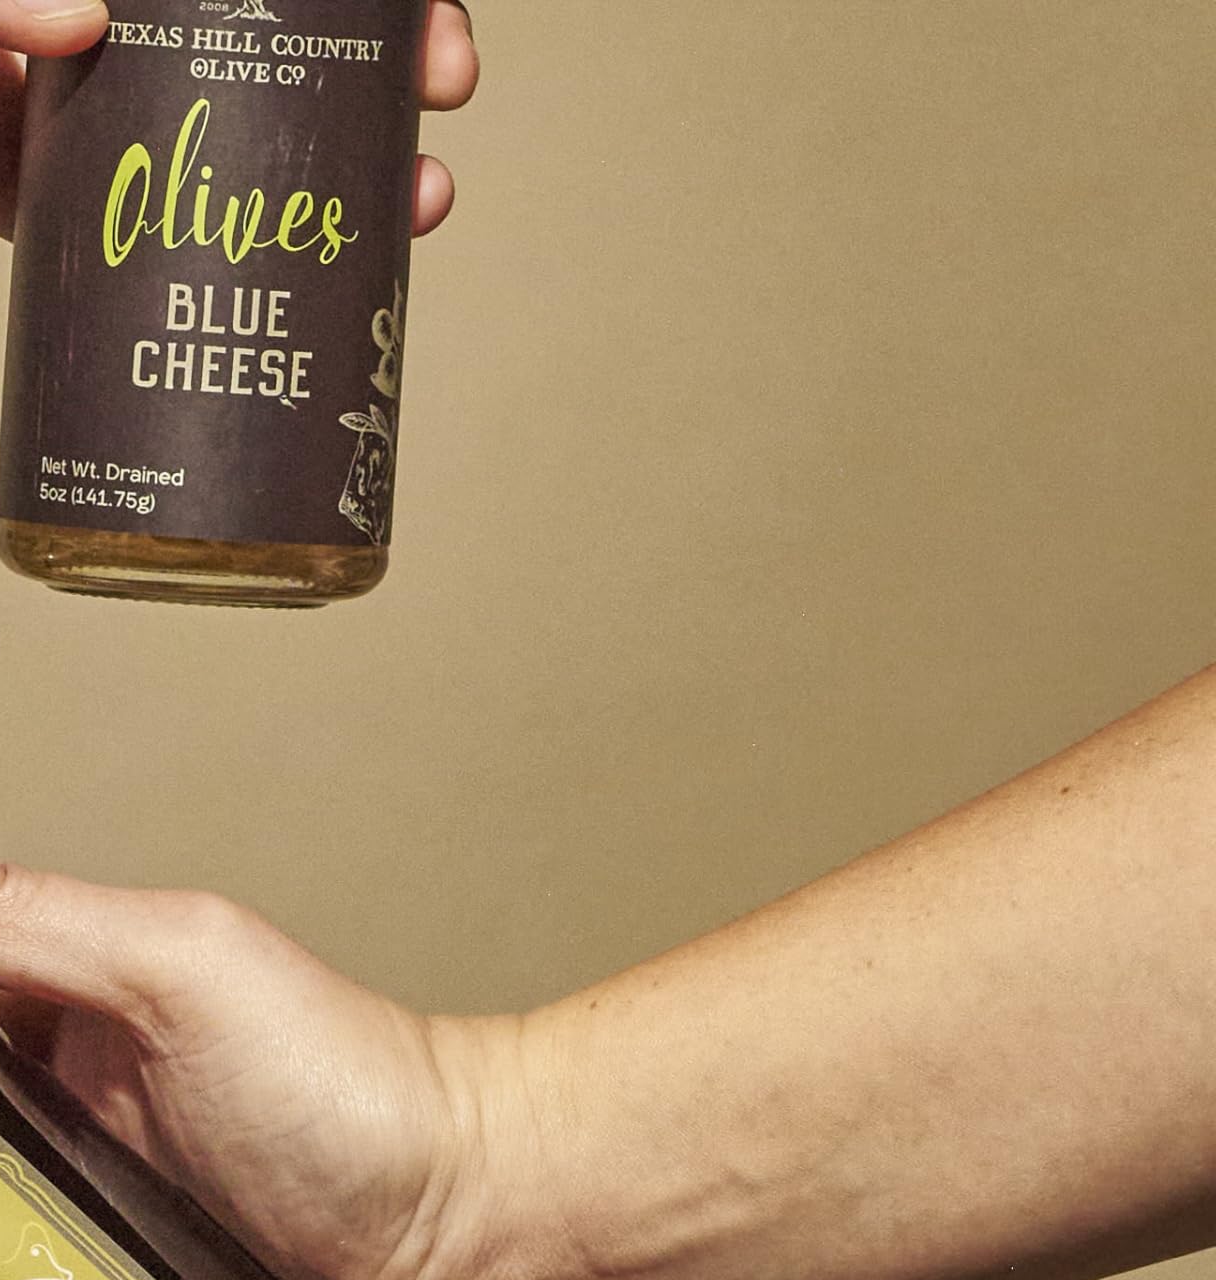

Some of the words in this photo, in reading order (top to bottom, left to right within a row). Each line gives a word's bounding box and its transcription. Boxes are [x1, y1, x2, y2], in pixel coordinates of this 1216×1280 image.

[199, 2, 229, 12] 2008
[107, 21, 184, 48] TEXAS
[191, 28, 261, 54] HILL
[271, 34, 384, 61] COUNTRY
[190, 57, 271, 83] OLIVE
[102, 98, 359, 268] Olives
[166, 283, 292, 337] BLUE
[132, 340, 313, 404] CHEESE
[41, 456, 67, 476] Net
[72, 459, 101, 479] Wt.
[105, 463, 185, 487] Drained
[39, 483, 67, 502] 5oz
[71, 486, 156, 515] (141.75g)
